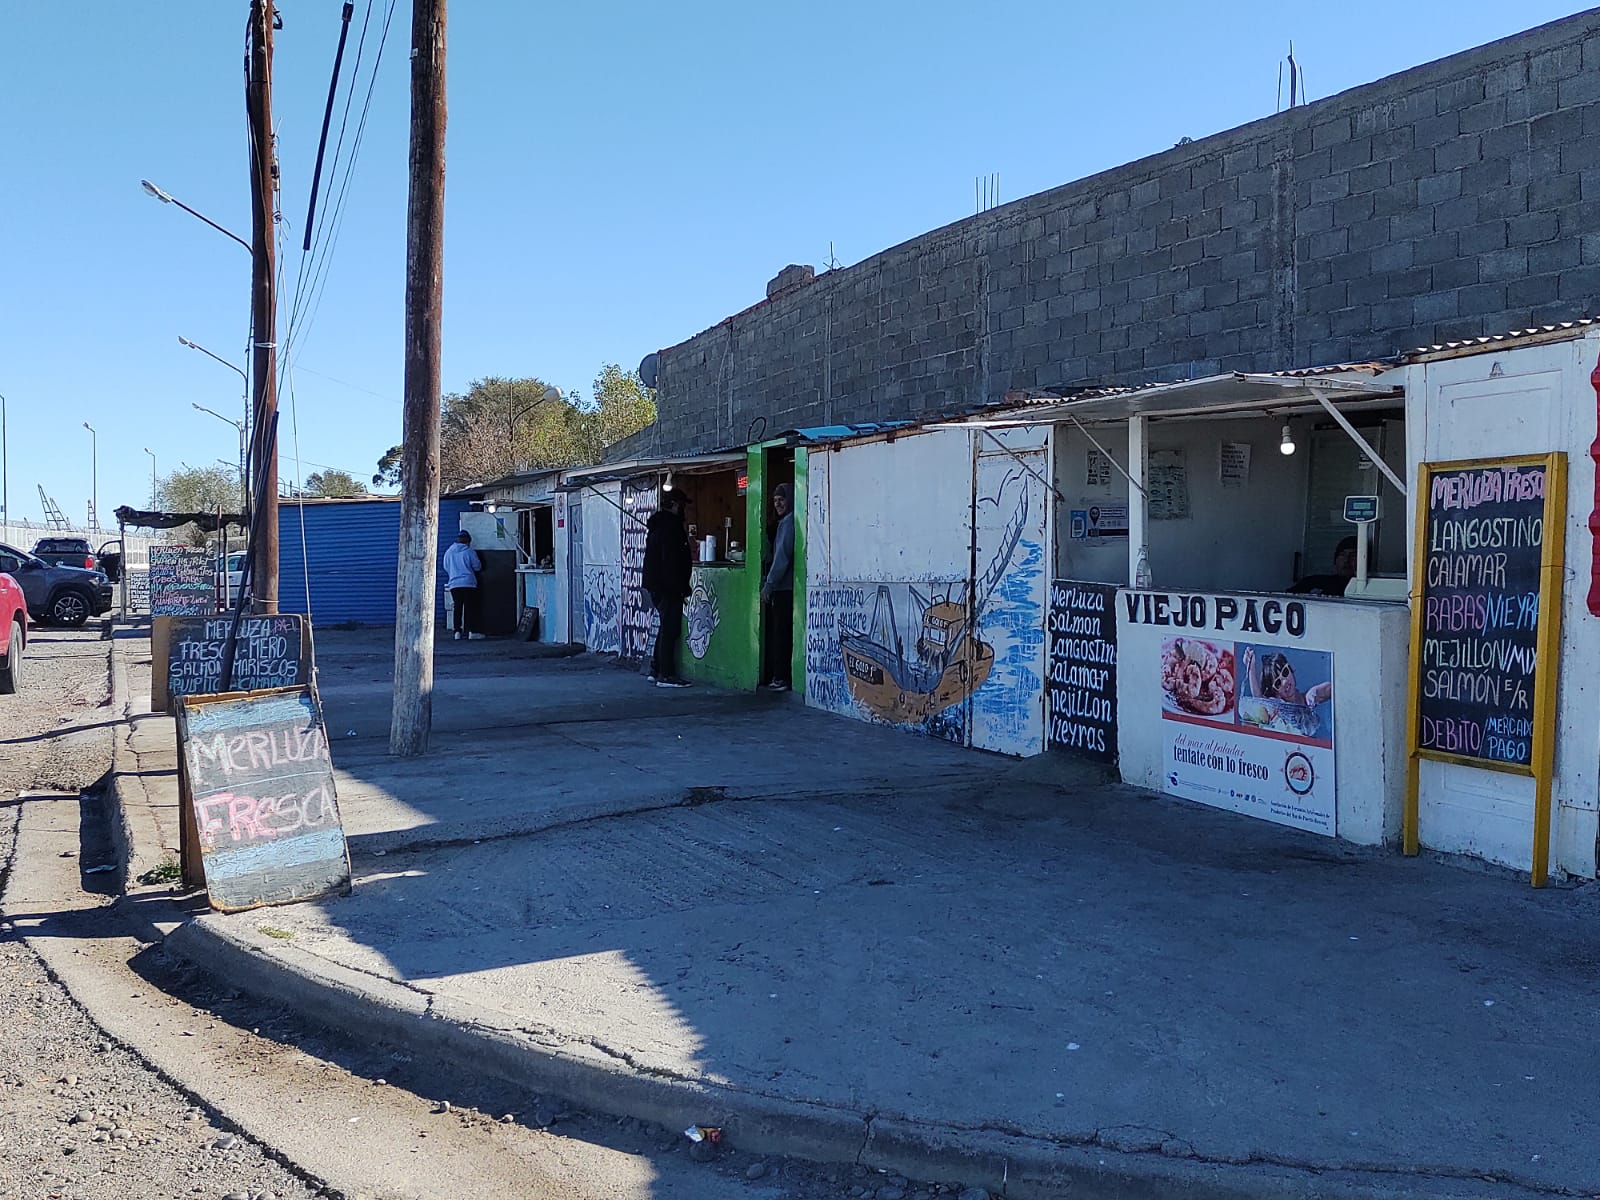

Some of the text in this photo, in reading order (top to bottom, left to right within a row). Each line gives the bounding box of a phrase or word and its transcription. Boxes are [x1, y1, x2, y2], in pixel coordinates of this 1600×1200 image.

[1430, 470, 1501, 511] MERLUZA
[1431, 516, 1543, 552] LANGOSTINO
[1427, 552, 1508, 587] CALAMAR
[1050, 585, 1105, 612] Merluza
[1125, 593, 1206, 629] VIEJO
[1049, 609, 1101, 636] Salmon
[179, 641, 238, 661] FRESC
[250, 636, 287, 659] MERO
[232, 659, 297, 677] MARISCOS
[1174, 733, 1245, 758] del mar al paladar
[1488, 735, 1526, 760] PAGO
[1174, 744, 1269, 780] tentate con lo fresco
